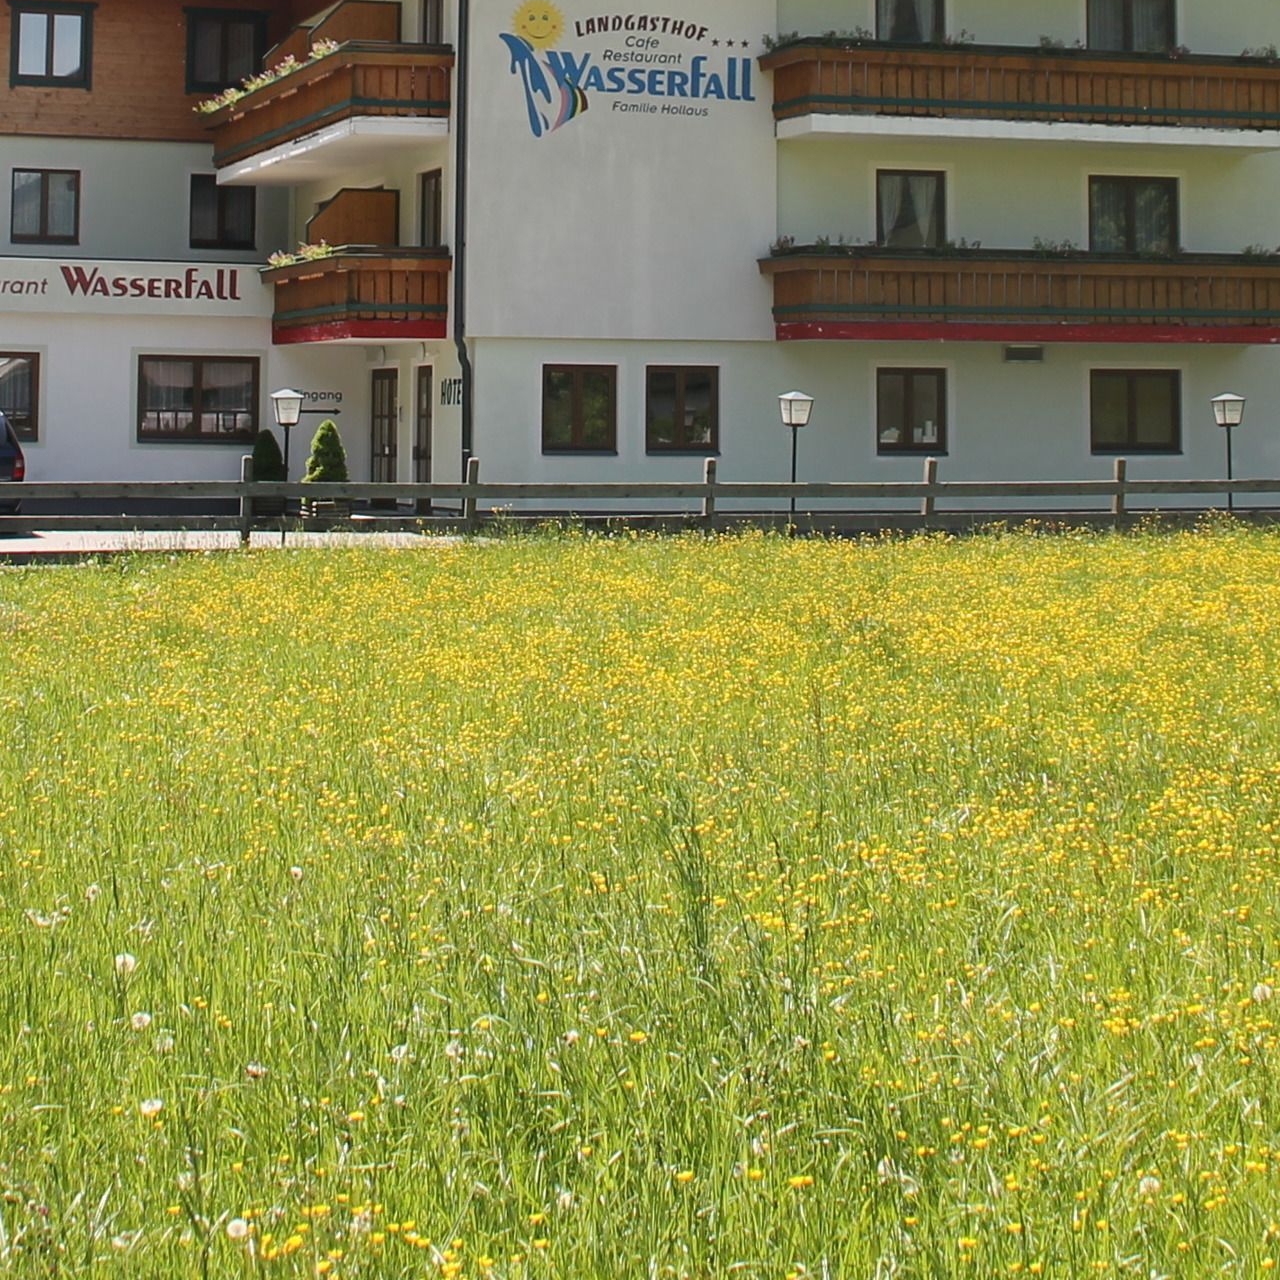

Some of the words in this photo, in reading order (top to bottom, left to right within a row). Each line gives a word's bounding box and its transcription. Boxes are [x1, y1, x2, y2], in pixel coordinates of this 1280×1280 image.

[575, 14, 708, 41] LANDGASTHOF
[625, 35, 660, 51] Cafe
[602, 49, 683, 64] Restaurant
[612, 101, 658, 114] Familie
[661, 102, 709, 117] Hollaus
[441, 378, 462, 405] HOTE
